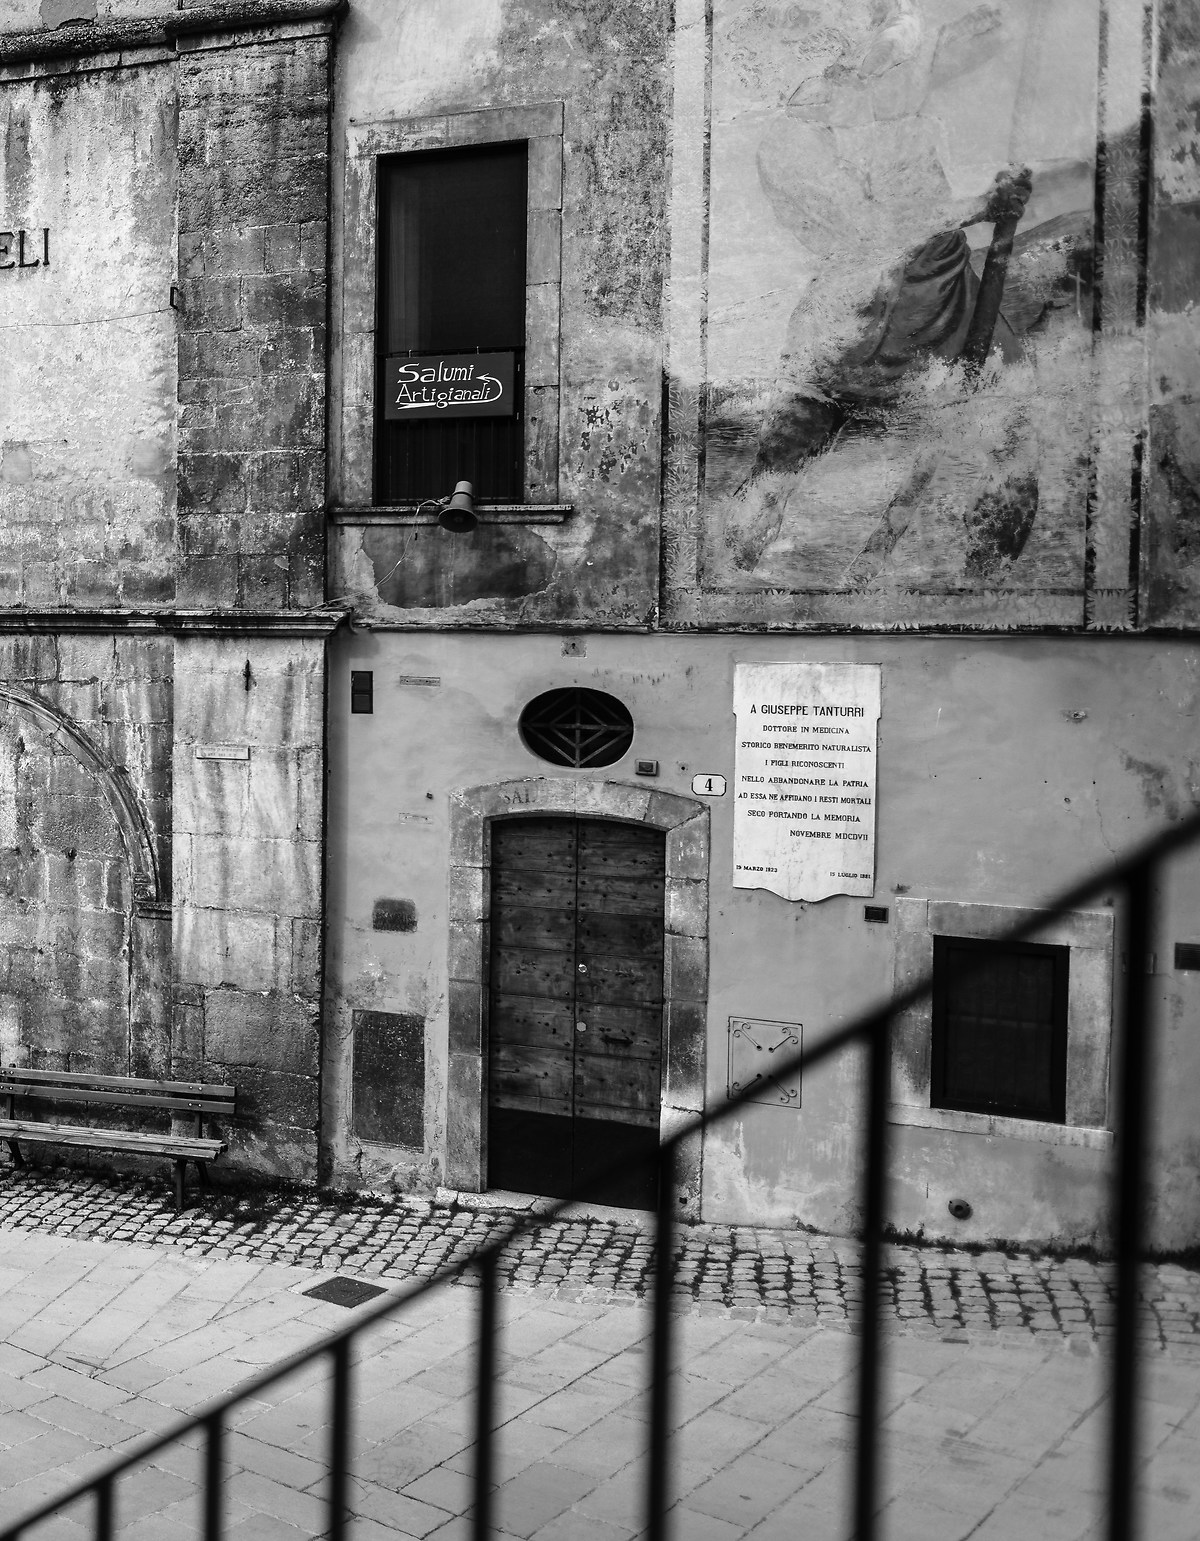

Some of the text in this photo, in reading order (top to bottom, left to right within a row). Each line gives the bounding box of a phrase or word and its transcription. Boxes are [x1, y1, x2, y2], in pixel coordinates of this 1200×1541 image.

[397, 361, 474, 383] Salumi
[395, 381, 491, 409] Artigianali
[750, 705, 863, 718] A GIUSEPPE TANTURRI
[762, 725, 797, 733] DOTTORE
[812, 727, 849, 735] MEDICINA
[773, 743, 819, 751] BENEMERITO
[821, 745, 871, 753] NATURALISTA
[791, 761, 844, 769] RICONOSCENTI
[704, 778, 713, 792] 4
[767, 777, 825, 786] ABBANDONARE
[842, 780, 868, 788] PATRIA
[779, 795, 812, 803] AFFIDANO
[818, 796, 838, 804] RESTI
[840, 797, 871, 806] MORTALI
[747, 810, 765, 818] SECO
[768, 811, 807, 820] PORTANDO
[823, 814, 860, 823] MEMORIA
[789, 830, 868, 841] NOVEMBRE MDCDVII
